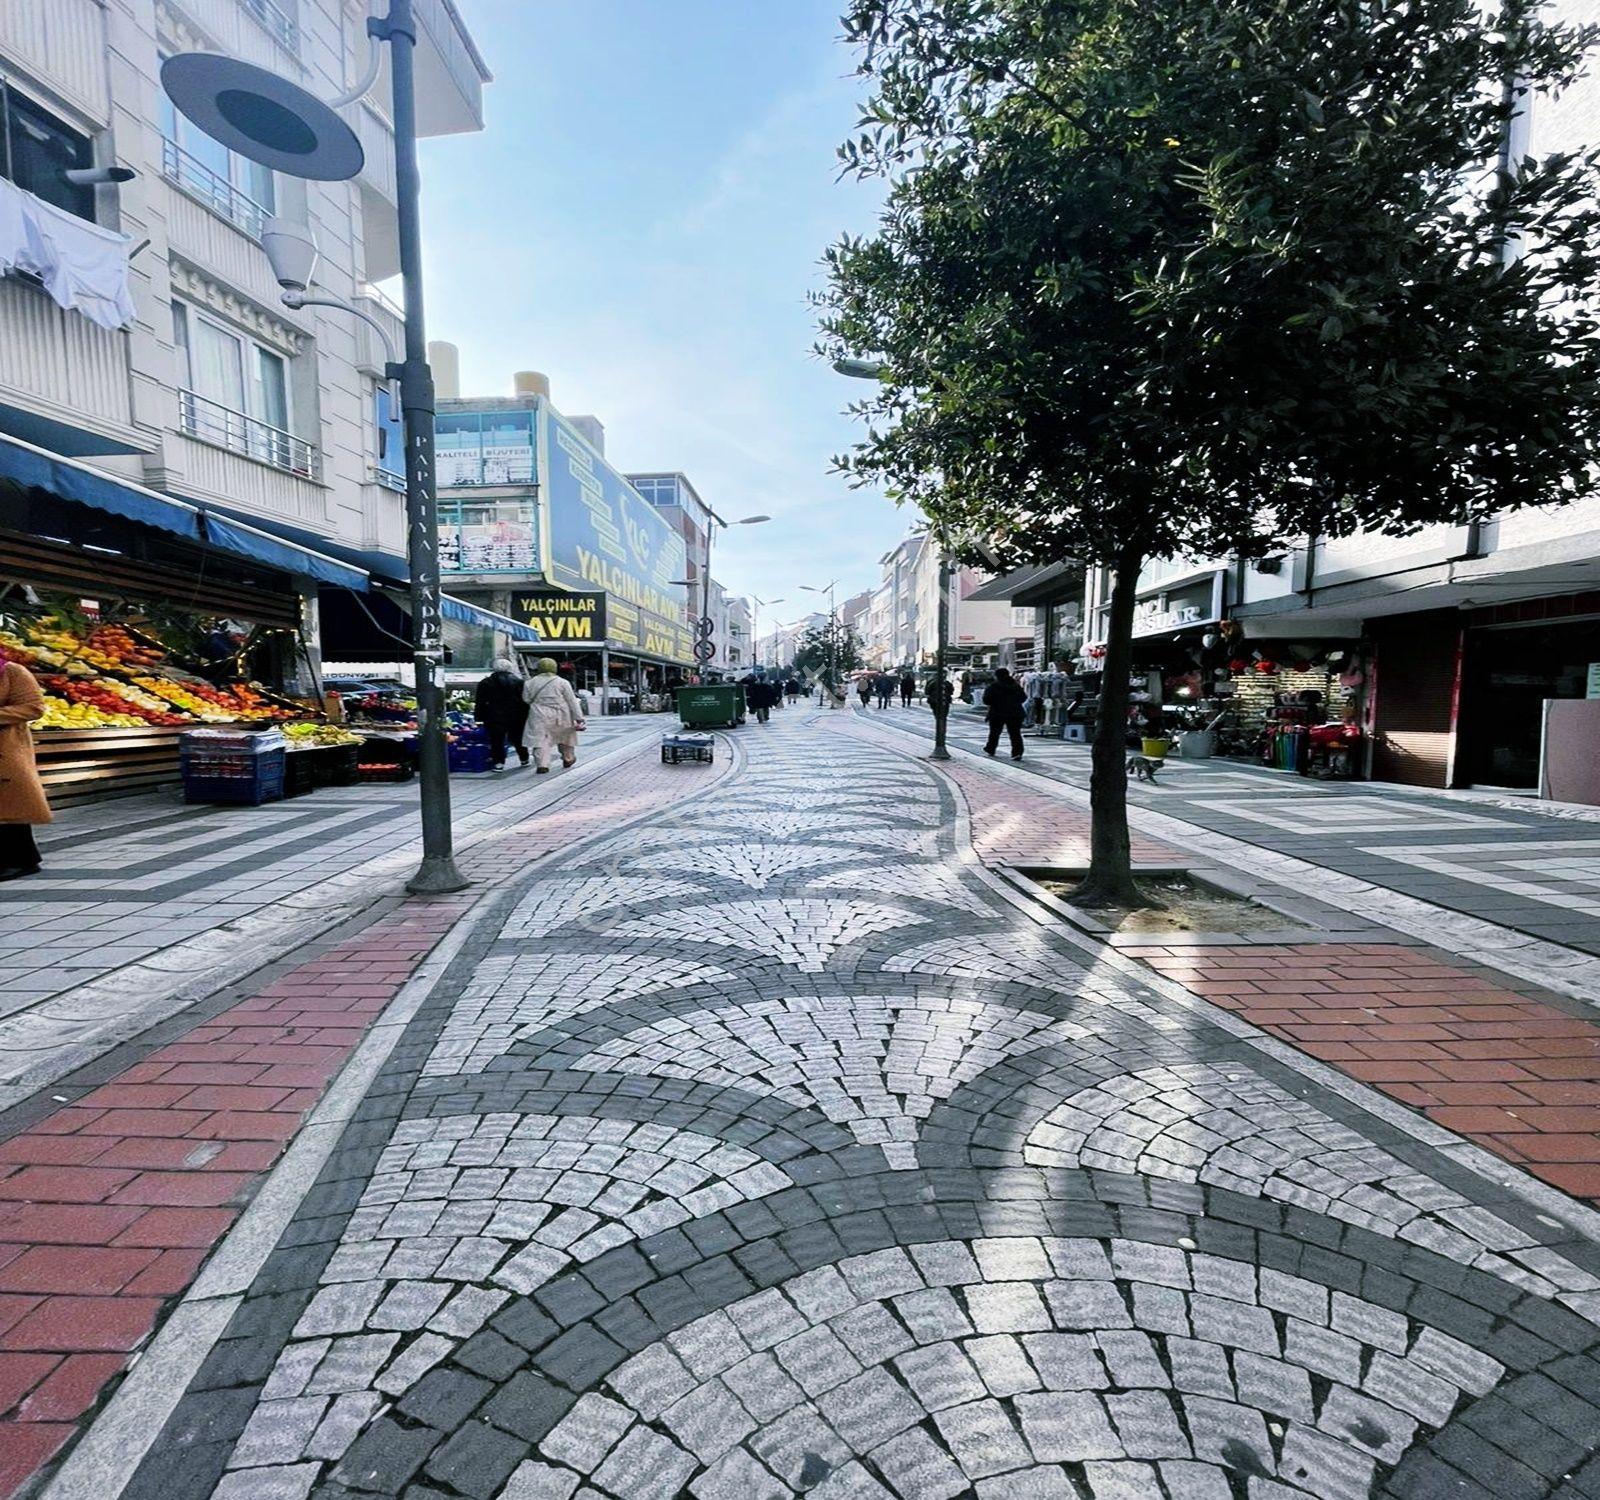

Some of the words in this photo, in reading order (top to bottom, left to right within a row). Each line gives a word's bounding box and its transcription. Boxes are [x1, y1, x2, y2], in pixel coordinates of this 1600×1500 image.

[520, 598, 596, 614] YALÇINLAR
[529, 616, 592, 638] AVM
[645, 633, 674, 656] AVM
